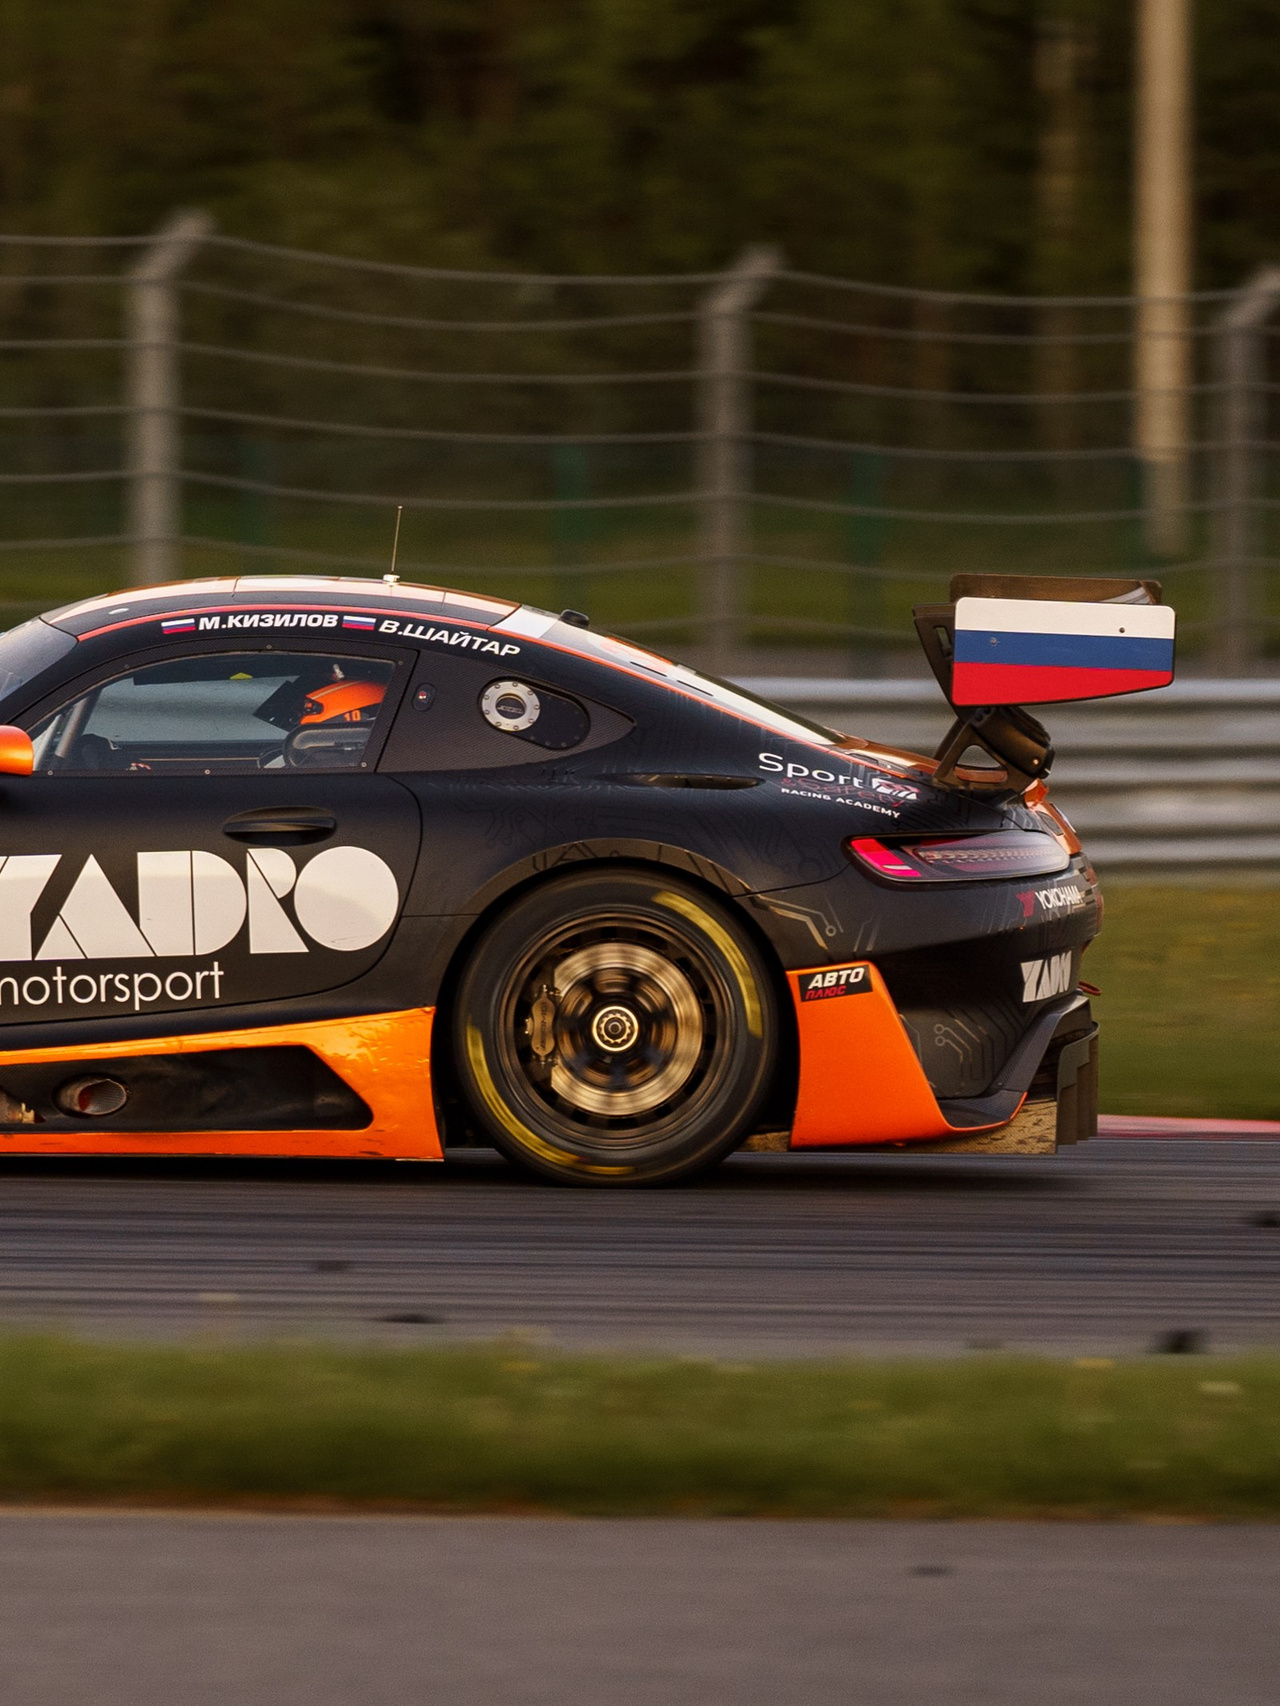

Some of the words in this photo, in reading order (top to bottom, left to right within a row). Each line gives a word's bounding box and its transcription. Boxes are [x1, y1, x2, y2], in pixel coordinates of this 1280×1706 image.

[198, 613, 338, 631] М.КИЗИЛОВ
[378, 619, 521, 658] В.ШАЙТАР
[758, 752, 864, 789] Sport
[781, 787, 832, 801] RACING
[835, 797, 901, 818] ACADEMY
[1034, 885, 1084, 910] YOKOHAMA
[807, 967, 865, 990] АВТО
